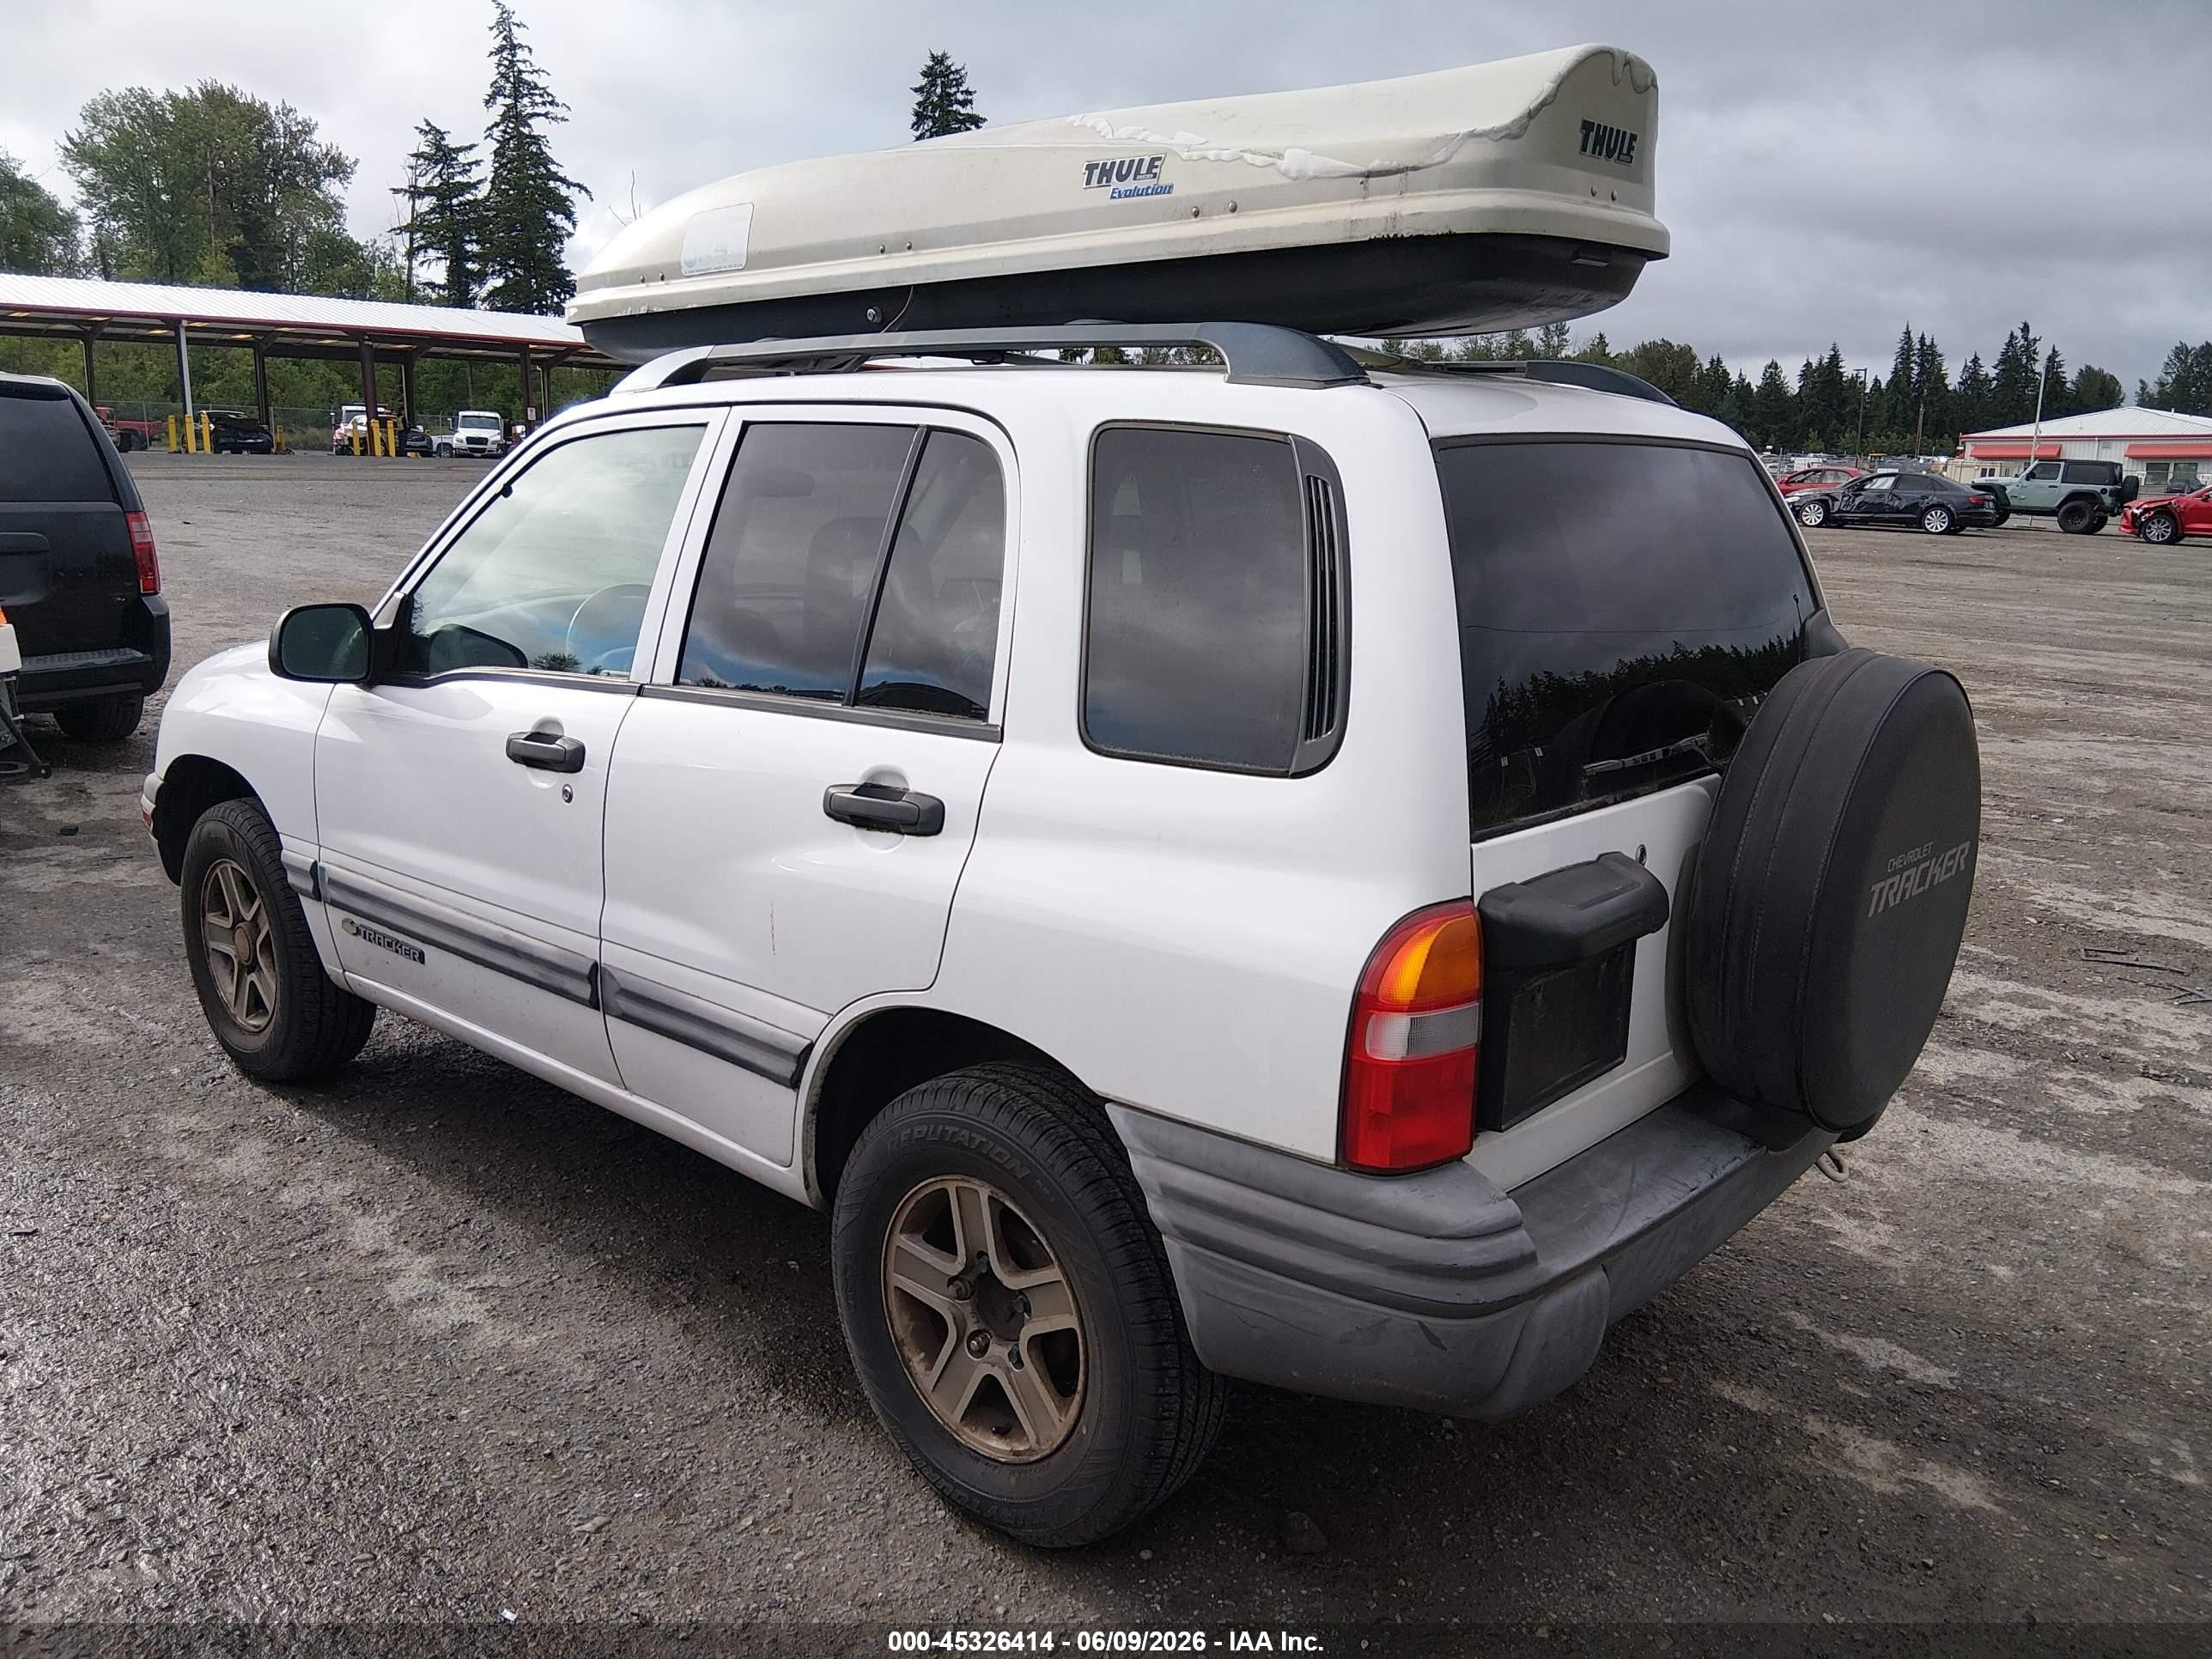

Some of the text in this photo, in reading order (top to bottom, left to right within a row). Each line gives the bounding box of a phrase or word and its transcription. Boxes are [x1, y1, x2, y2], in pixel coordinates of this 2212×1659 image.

[1581, 119, 1638, 163] THULE
[1085, 156, 1163, 186] THULE
[1109, 184, 1173, 199] Evolution
[1887, 842, 1934, 872] CHEVROLET
[1869, 841, 1971, 918] TRACKER
[358, 926, 420, 962] TRACKER
